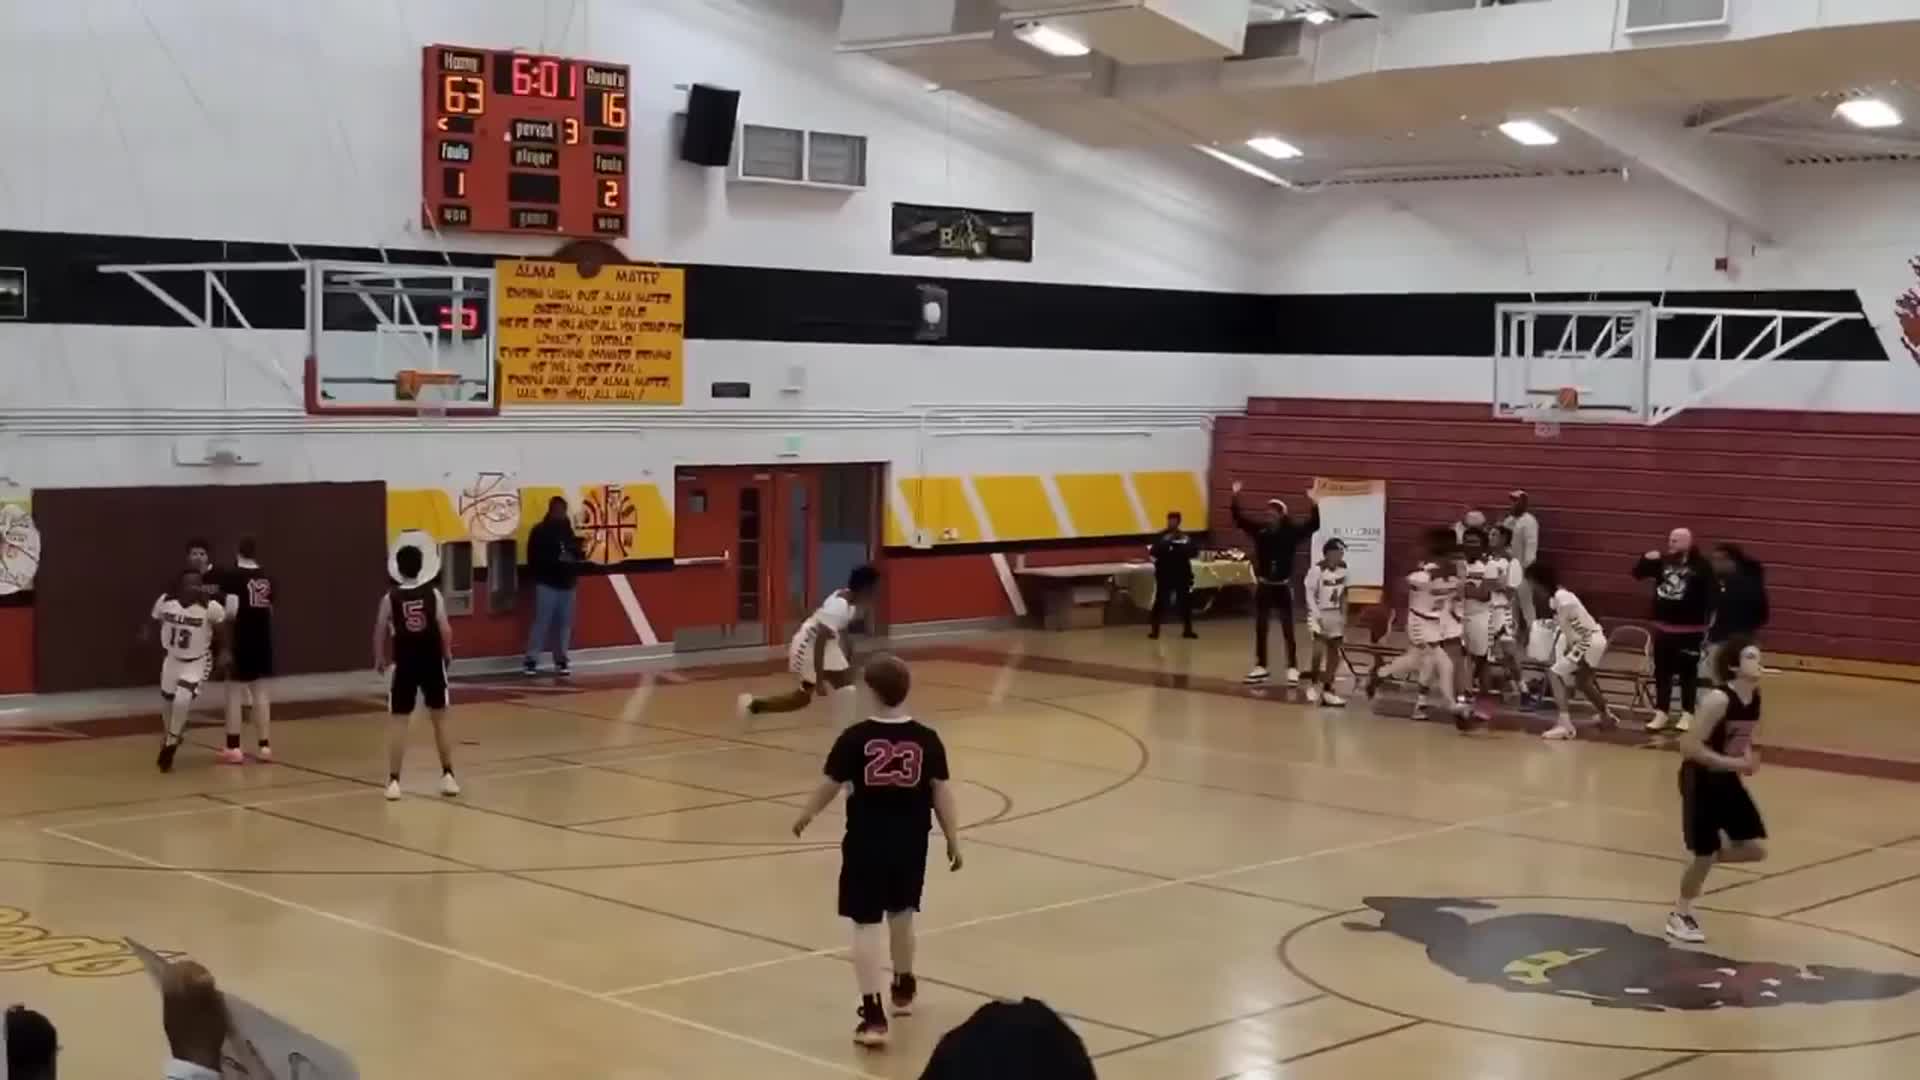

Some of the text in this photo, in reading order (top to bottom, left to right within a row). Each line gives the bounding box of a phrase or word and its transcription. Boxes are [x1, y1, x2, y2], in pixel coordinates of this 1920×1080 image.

[513, 58, 577, 97] 6:01
[445, 75, 485, 114] 63
[602, 92, 626, 128] 16
[564, 117, 579, 144] 3
[458, 171, 465, 196] 1
[604, 181, 619, 207] 2
[515, 263, 556, 279] ALMA
[247, 578, 271, 608] 12
[402, 599, 426, 632] 5
[864, 738, 923, 787] 23
